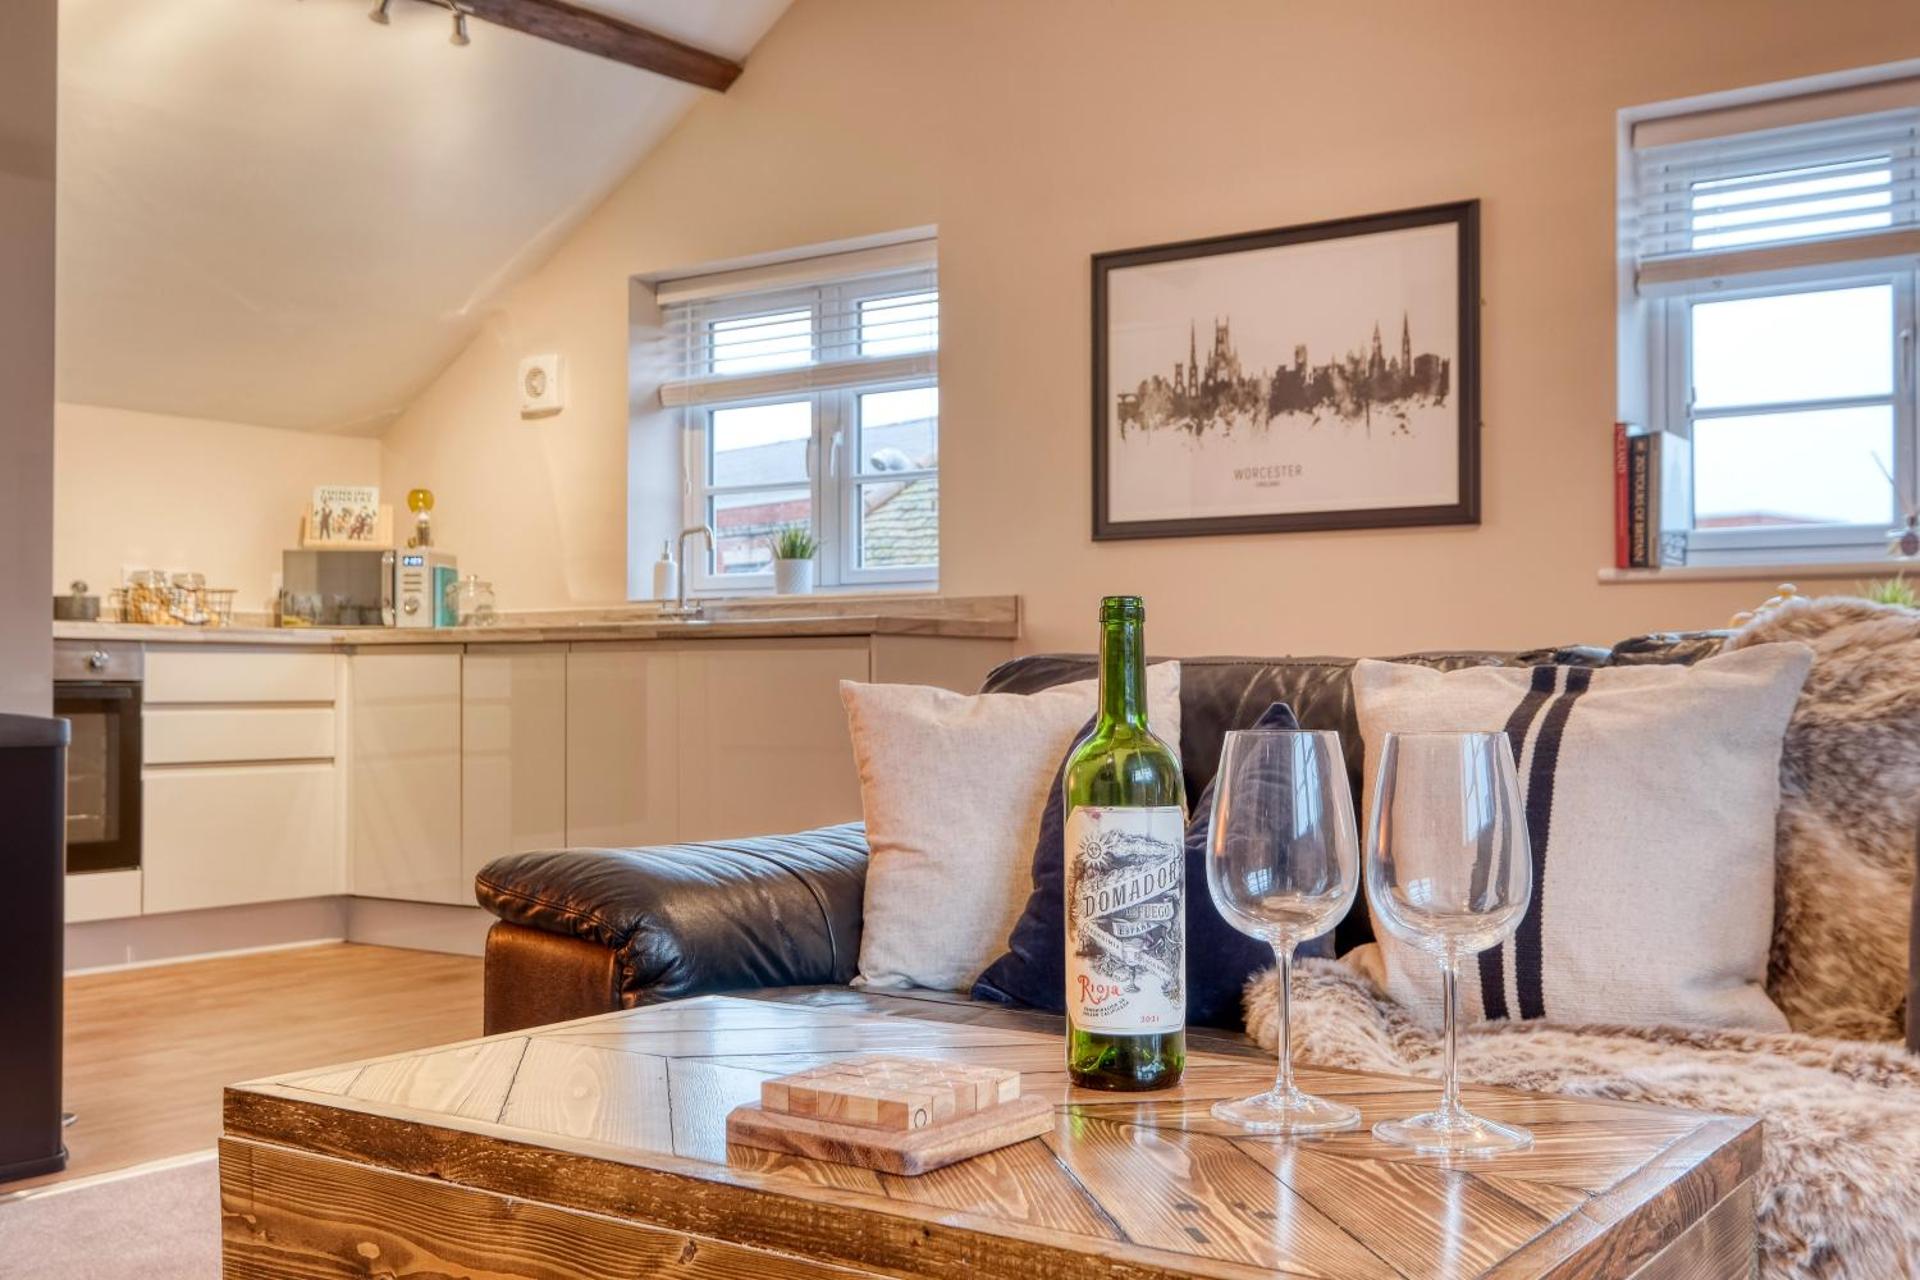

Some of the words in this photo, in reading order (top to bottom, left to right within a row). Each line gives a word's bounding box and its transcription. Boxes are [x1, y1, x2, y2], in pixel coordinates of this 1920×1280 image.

[1233, 464, 1303, 480] WORCESTER
[1085, 861, 1177, 918] DOMADOR
[1138, 904, 1170, 919] FUEGO
[1141, 1015, 1160, 1023] 2021
